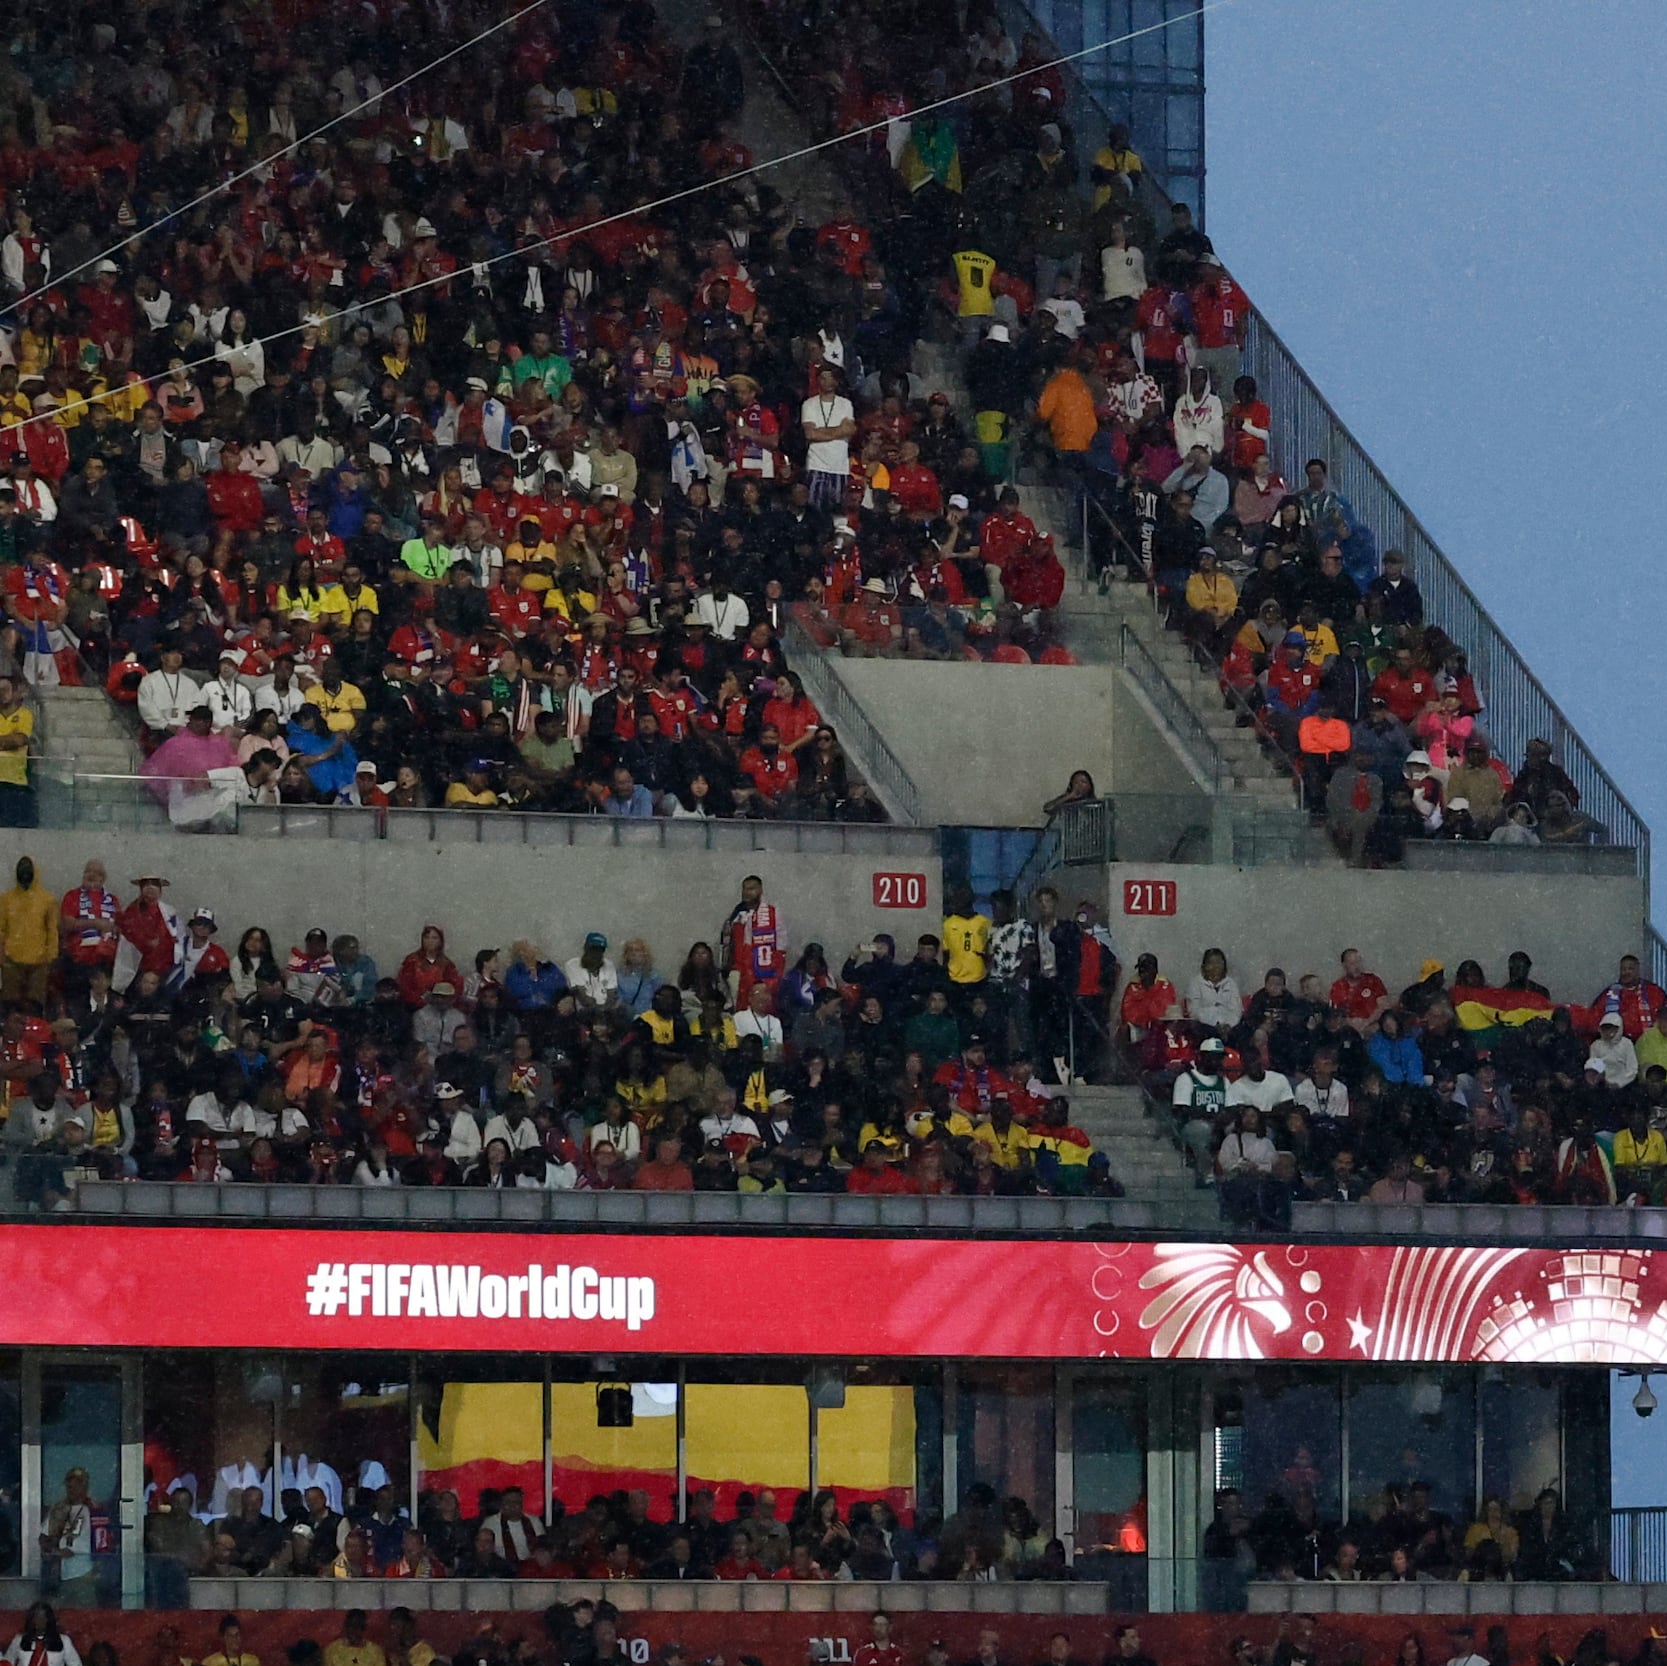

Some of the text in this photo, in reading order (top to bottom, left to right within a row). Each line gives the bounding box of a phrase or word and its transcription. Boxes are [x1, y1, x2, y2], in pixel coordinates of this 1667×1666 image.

[879, 877, 919, 904] 210
[1130, 884, 1166, 911] 211
[306, 1263, 655, 1330] #FIFAWorldCup
[616, 1637, 649, 1664] 10
[808, 1637, 850, 1661] 11
